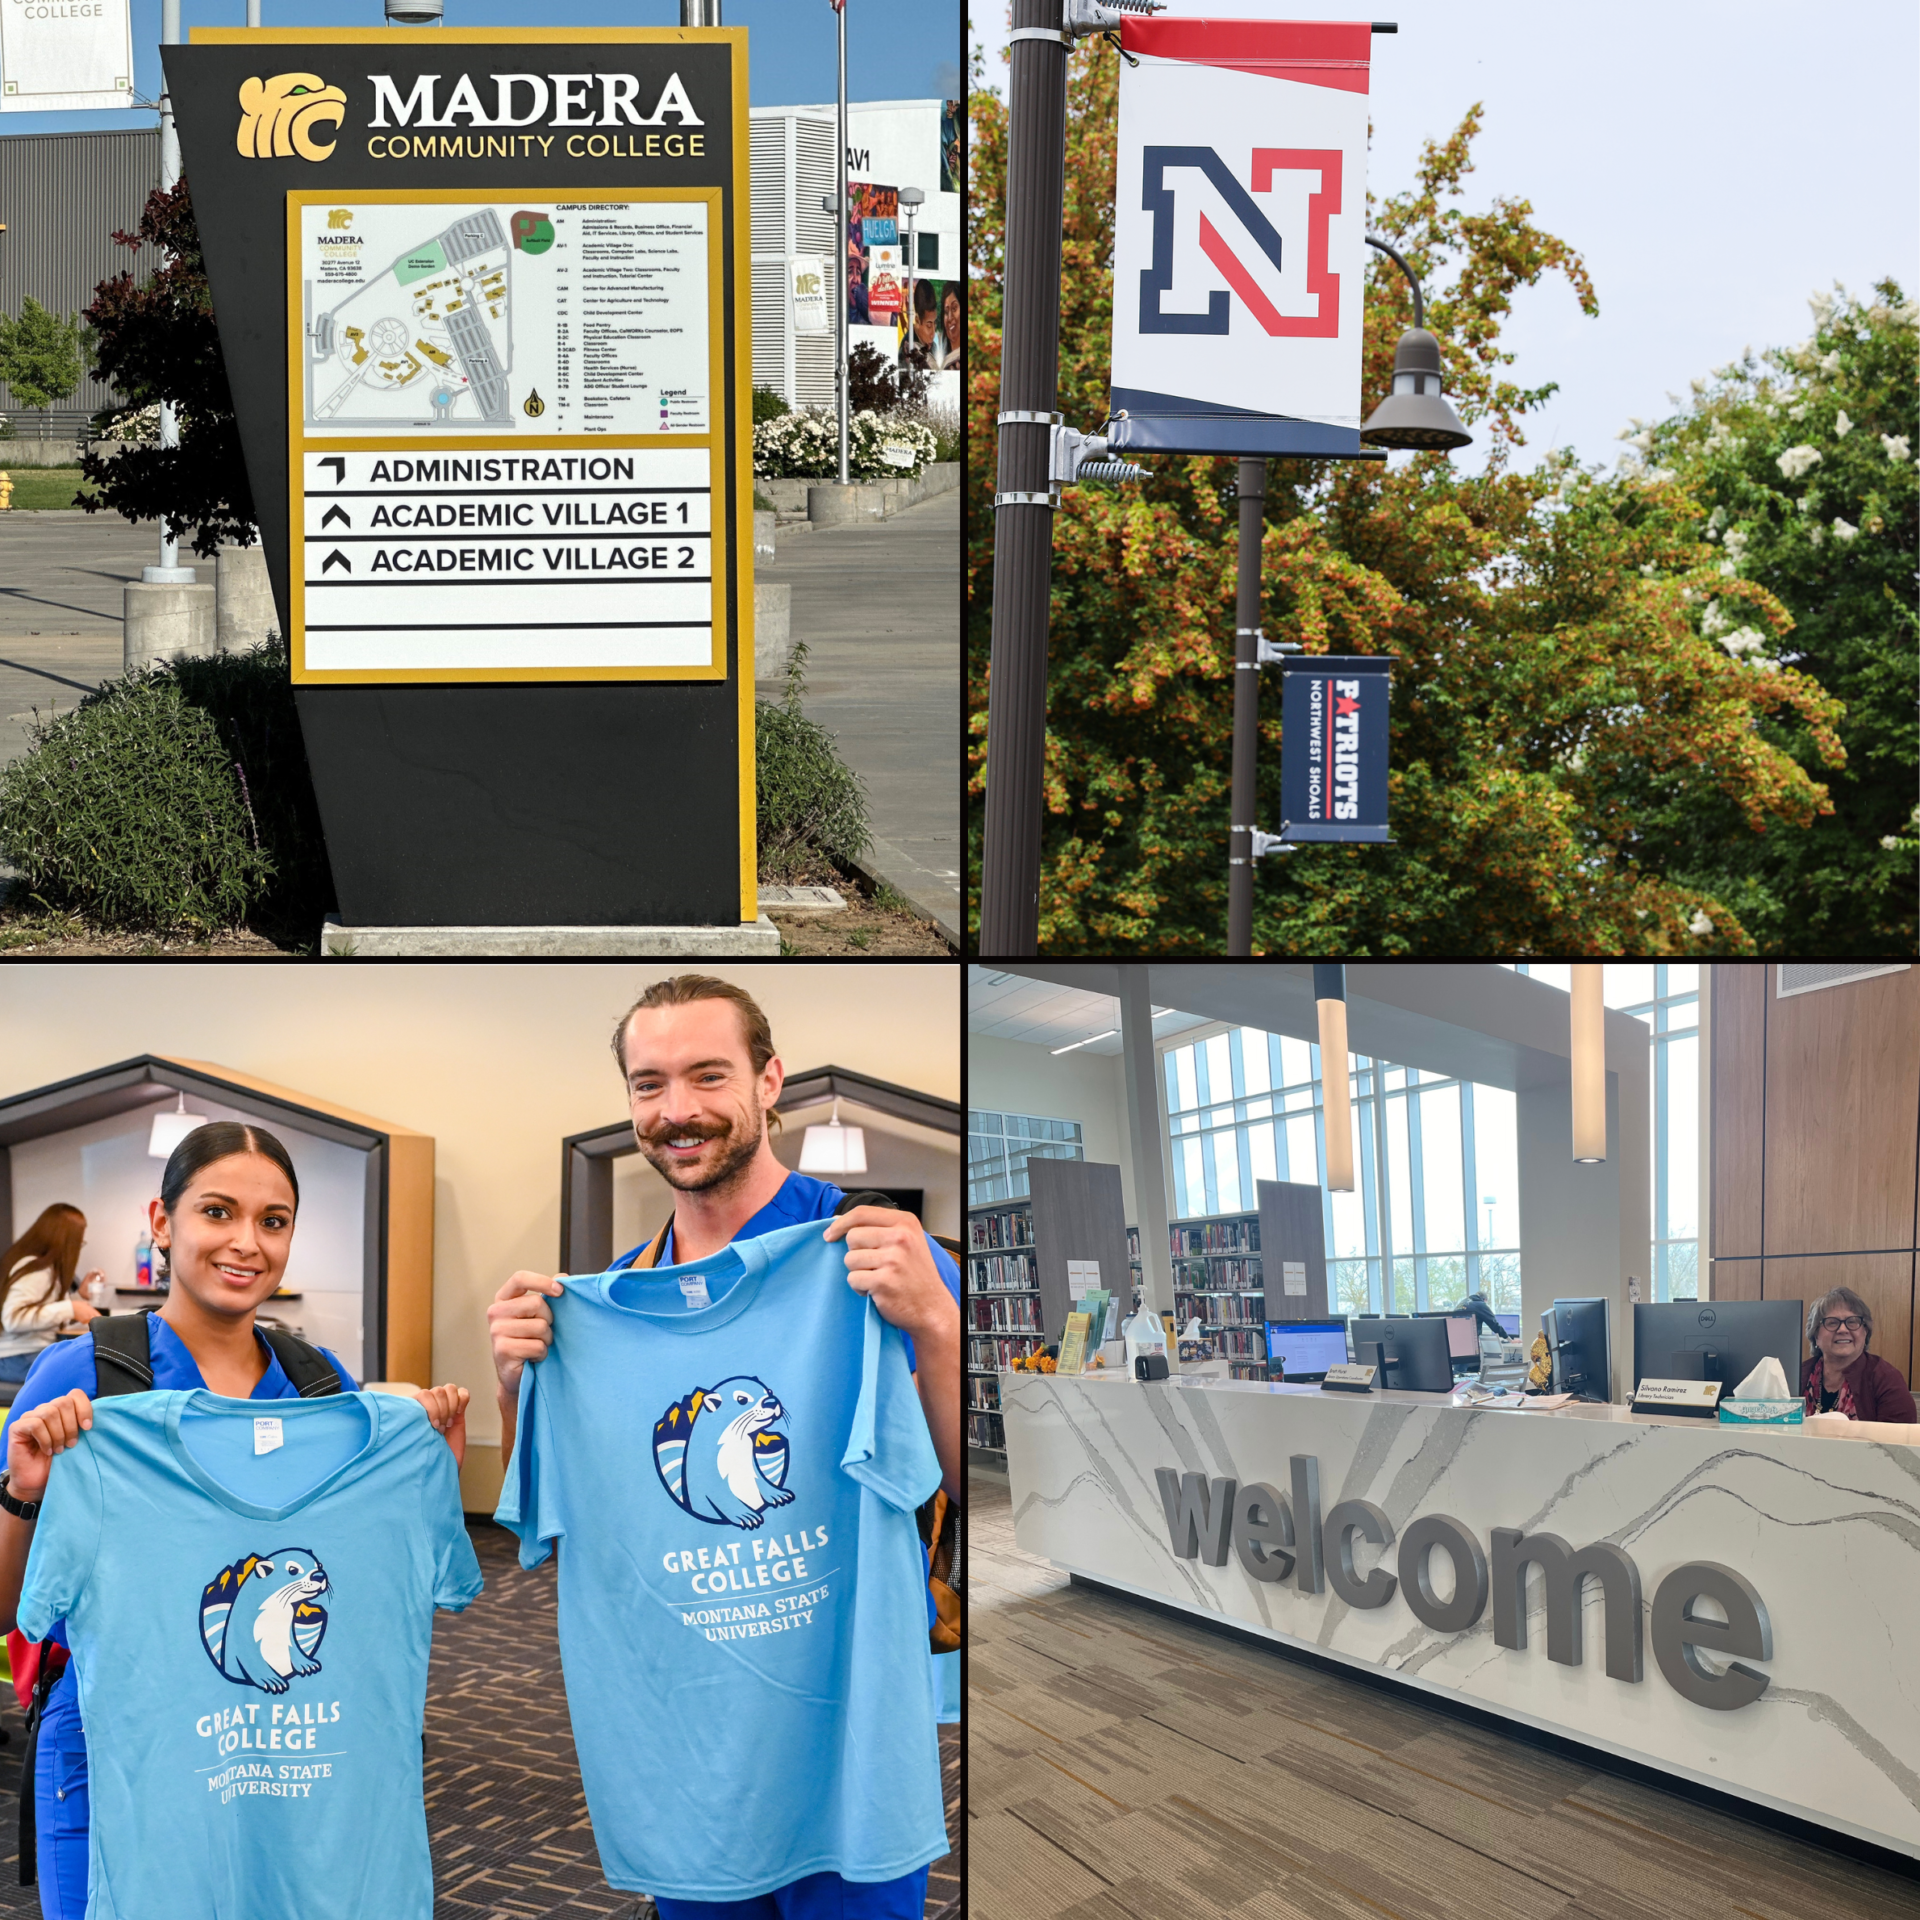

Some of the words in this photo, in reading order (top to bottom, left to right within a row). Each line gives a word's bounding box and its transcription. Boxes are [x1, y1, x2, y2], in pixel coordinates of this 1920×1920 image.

[25, 4, 103, 19] COLLEGE
[367, 72, 705, 128] MADERA
[368, 134, 555, 159] COMMUNITY
[566, 134, 705, 157] COLLEGE
[847, 147, 869, 172] AV1
[318, 236, 364, 244] MADERA
[864, 219, 897, 238] HUELGA
[1139, 145, 1343, 338] N
[661, 389, 686, 397] Legend
[530, 403, 538, 414] N
[370, 458, 634, 482] ADMINISTRATION
[370, 503, 534, 527] ACADEMIC
[542, 502, 668, 525] VILLAGE
[676, 502, 688, 524] 1
[370, 548, 534, 572] ACADEMIC
[543, 547, 668, 570] VILLAGE
[678, 546, 695, 569] 2
[1310, 680, 1322, 762] NORTHWEST
[1309, 767, 1321, 819] SHOALS
[663, 1543, 741, 1573] GREAT
[751, 1525, 829, 1561] FALLS
[691, 1557, 808, 1594] COLLEGE
[1154, 1454, 1773, 1711] welcome
[681, 1603, 771, 1626] MONTANA
[774, 1584, 829, 1614] STATE
[705, 1610, 813, 1641] UNIVERSITY
[196, 1704, 260, 1737] GREAT
[272, 1701, 340, 1725] FALLS
[218, 1728, 316, 1756] COLLEGE
[279, 1764, 332, 1779] STATE
